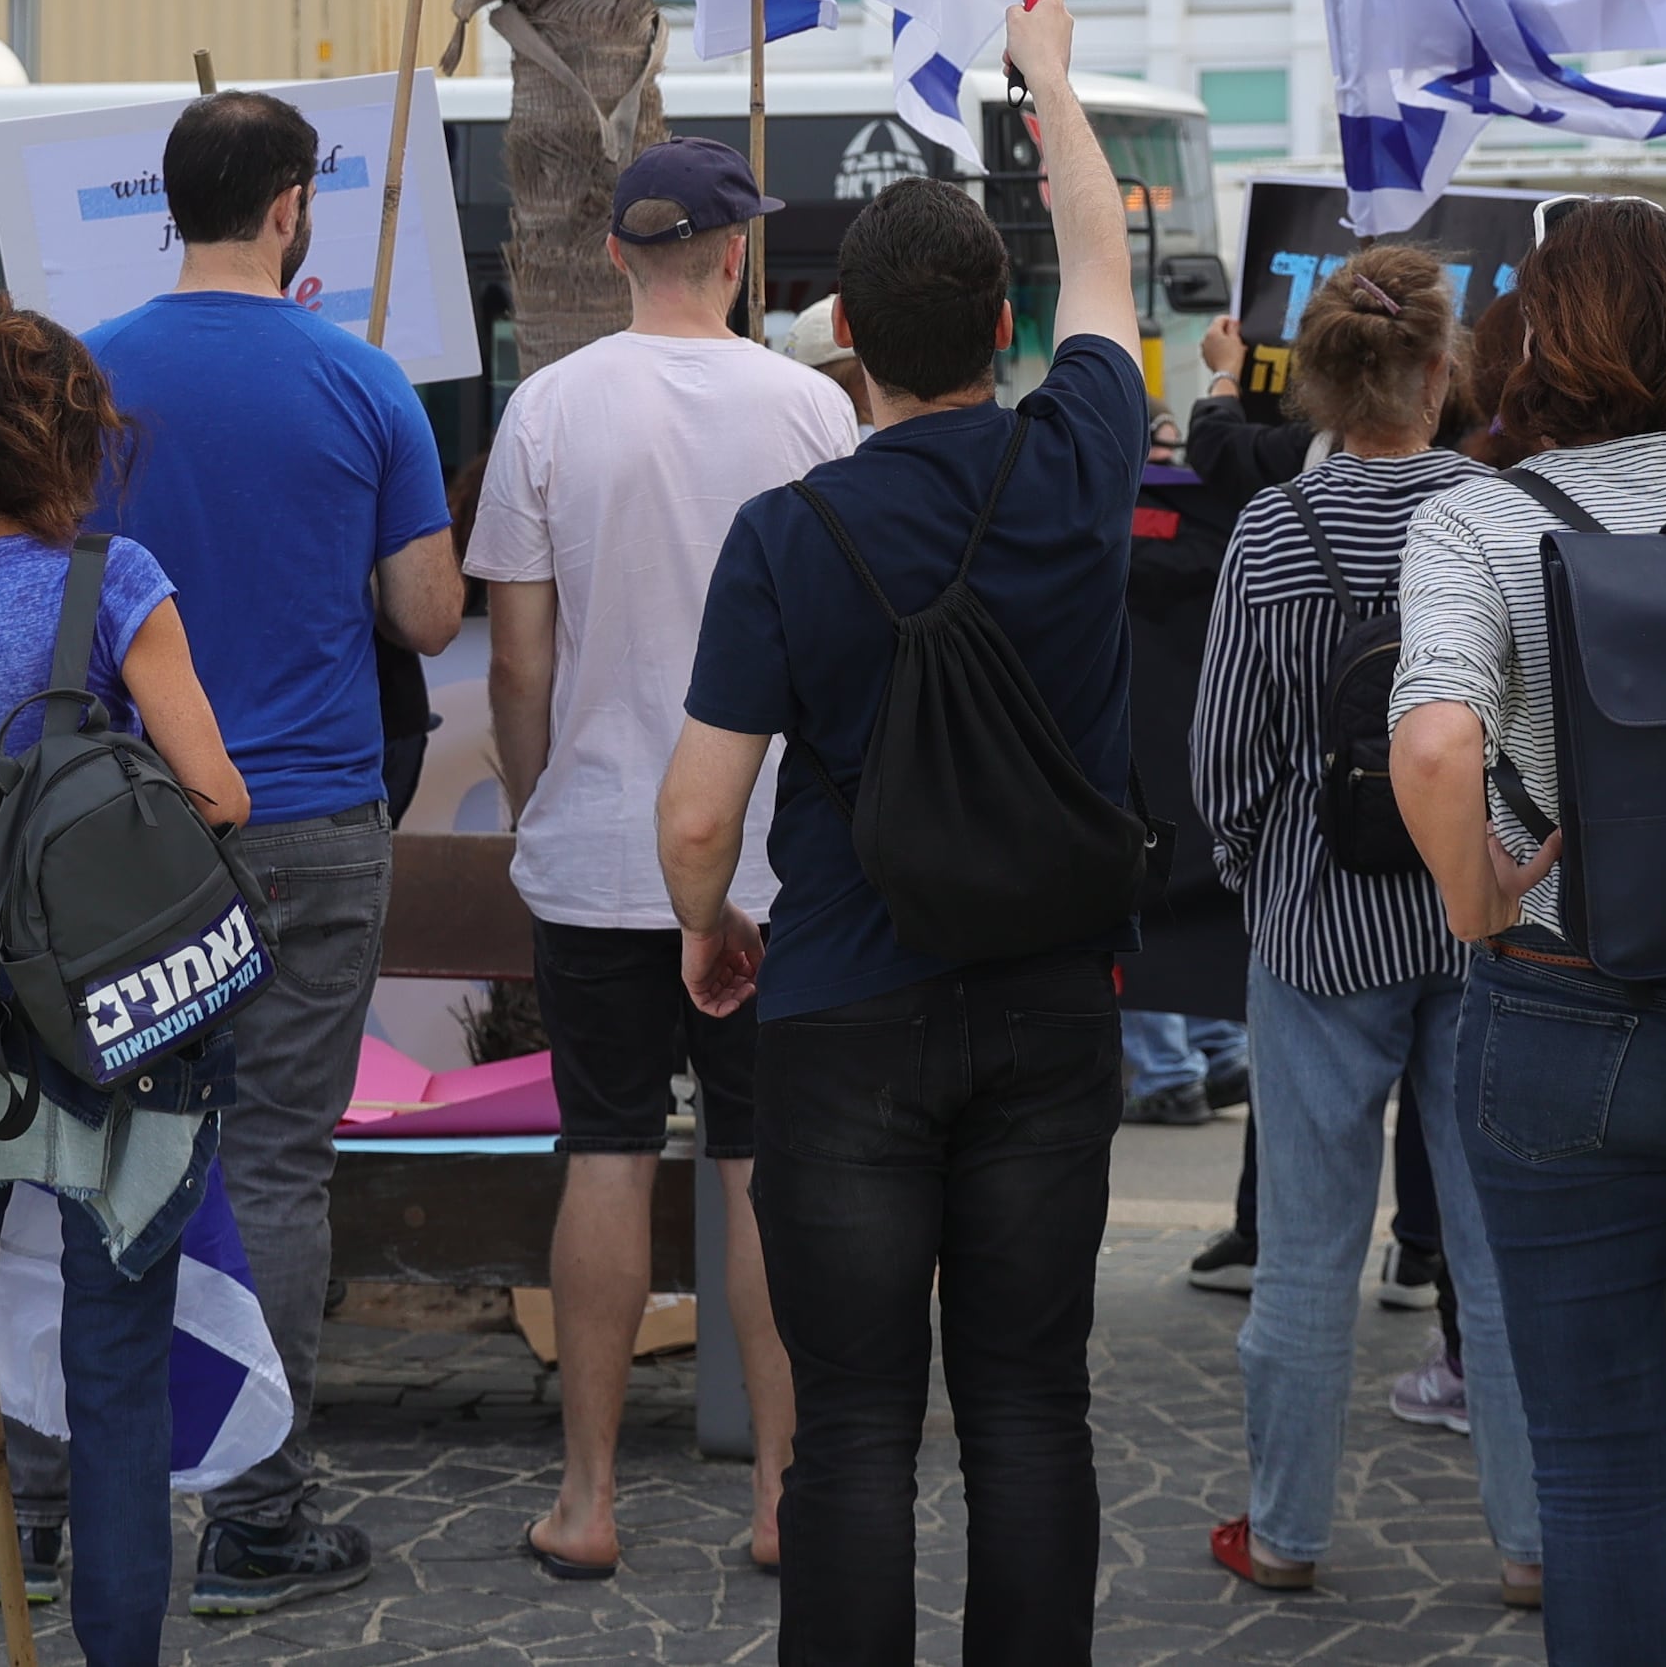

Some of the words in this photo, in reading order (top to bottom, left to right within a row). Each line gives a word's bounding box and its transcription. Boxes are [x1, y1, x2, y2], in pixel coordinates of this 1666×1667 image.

[110, 170, 166, 200] wit
[86, 904, 254, 1046] נאמנים
[204, 951, 263, 1014] למגילת
[101, 1000, 204, 1071] העצמאות
